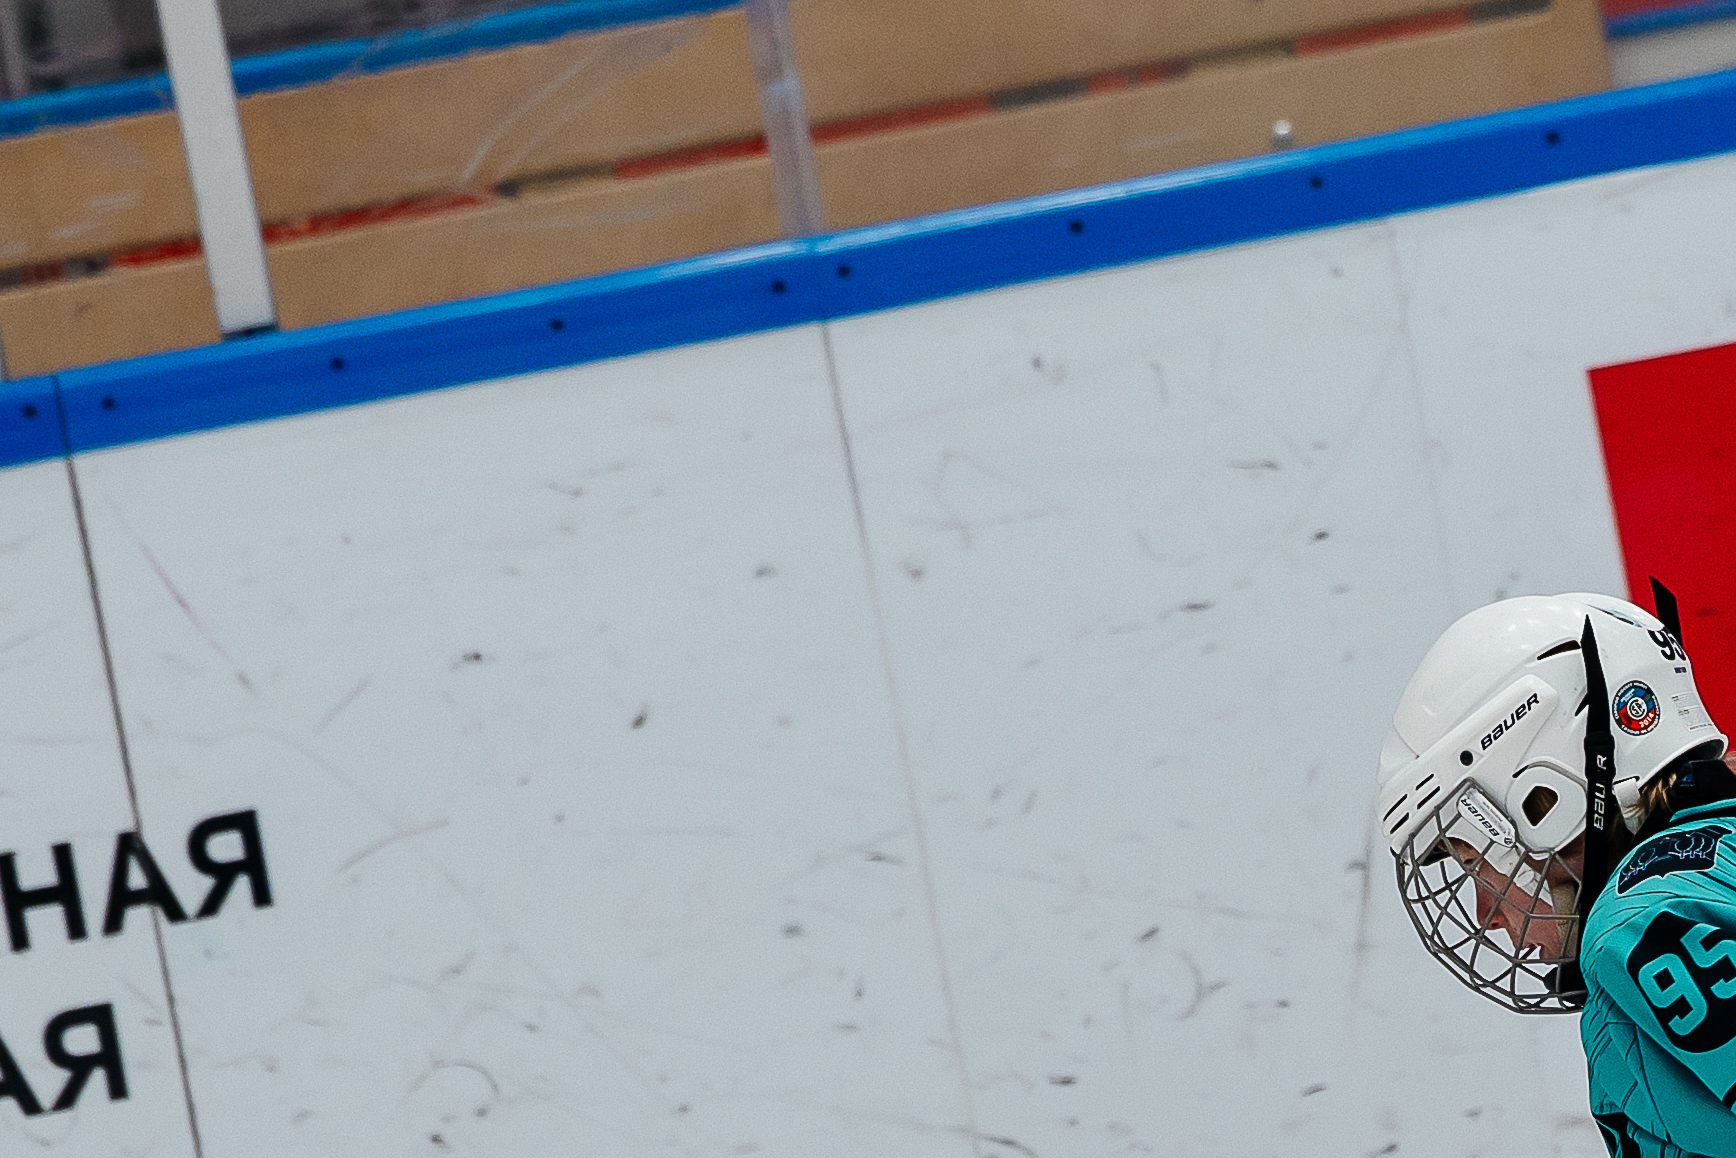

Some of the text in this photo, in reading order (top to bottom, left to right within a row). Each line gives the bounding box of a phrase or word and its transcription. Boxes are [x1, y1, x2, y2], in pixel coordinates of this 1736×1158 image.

[1479, 692, 1540, 751] BAUER
[1460, 798, 1500, 837] BAUER
[1593, 754, 1608, 831] BAUR
